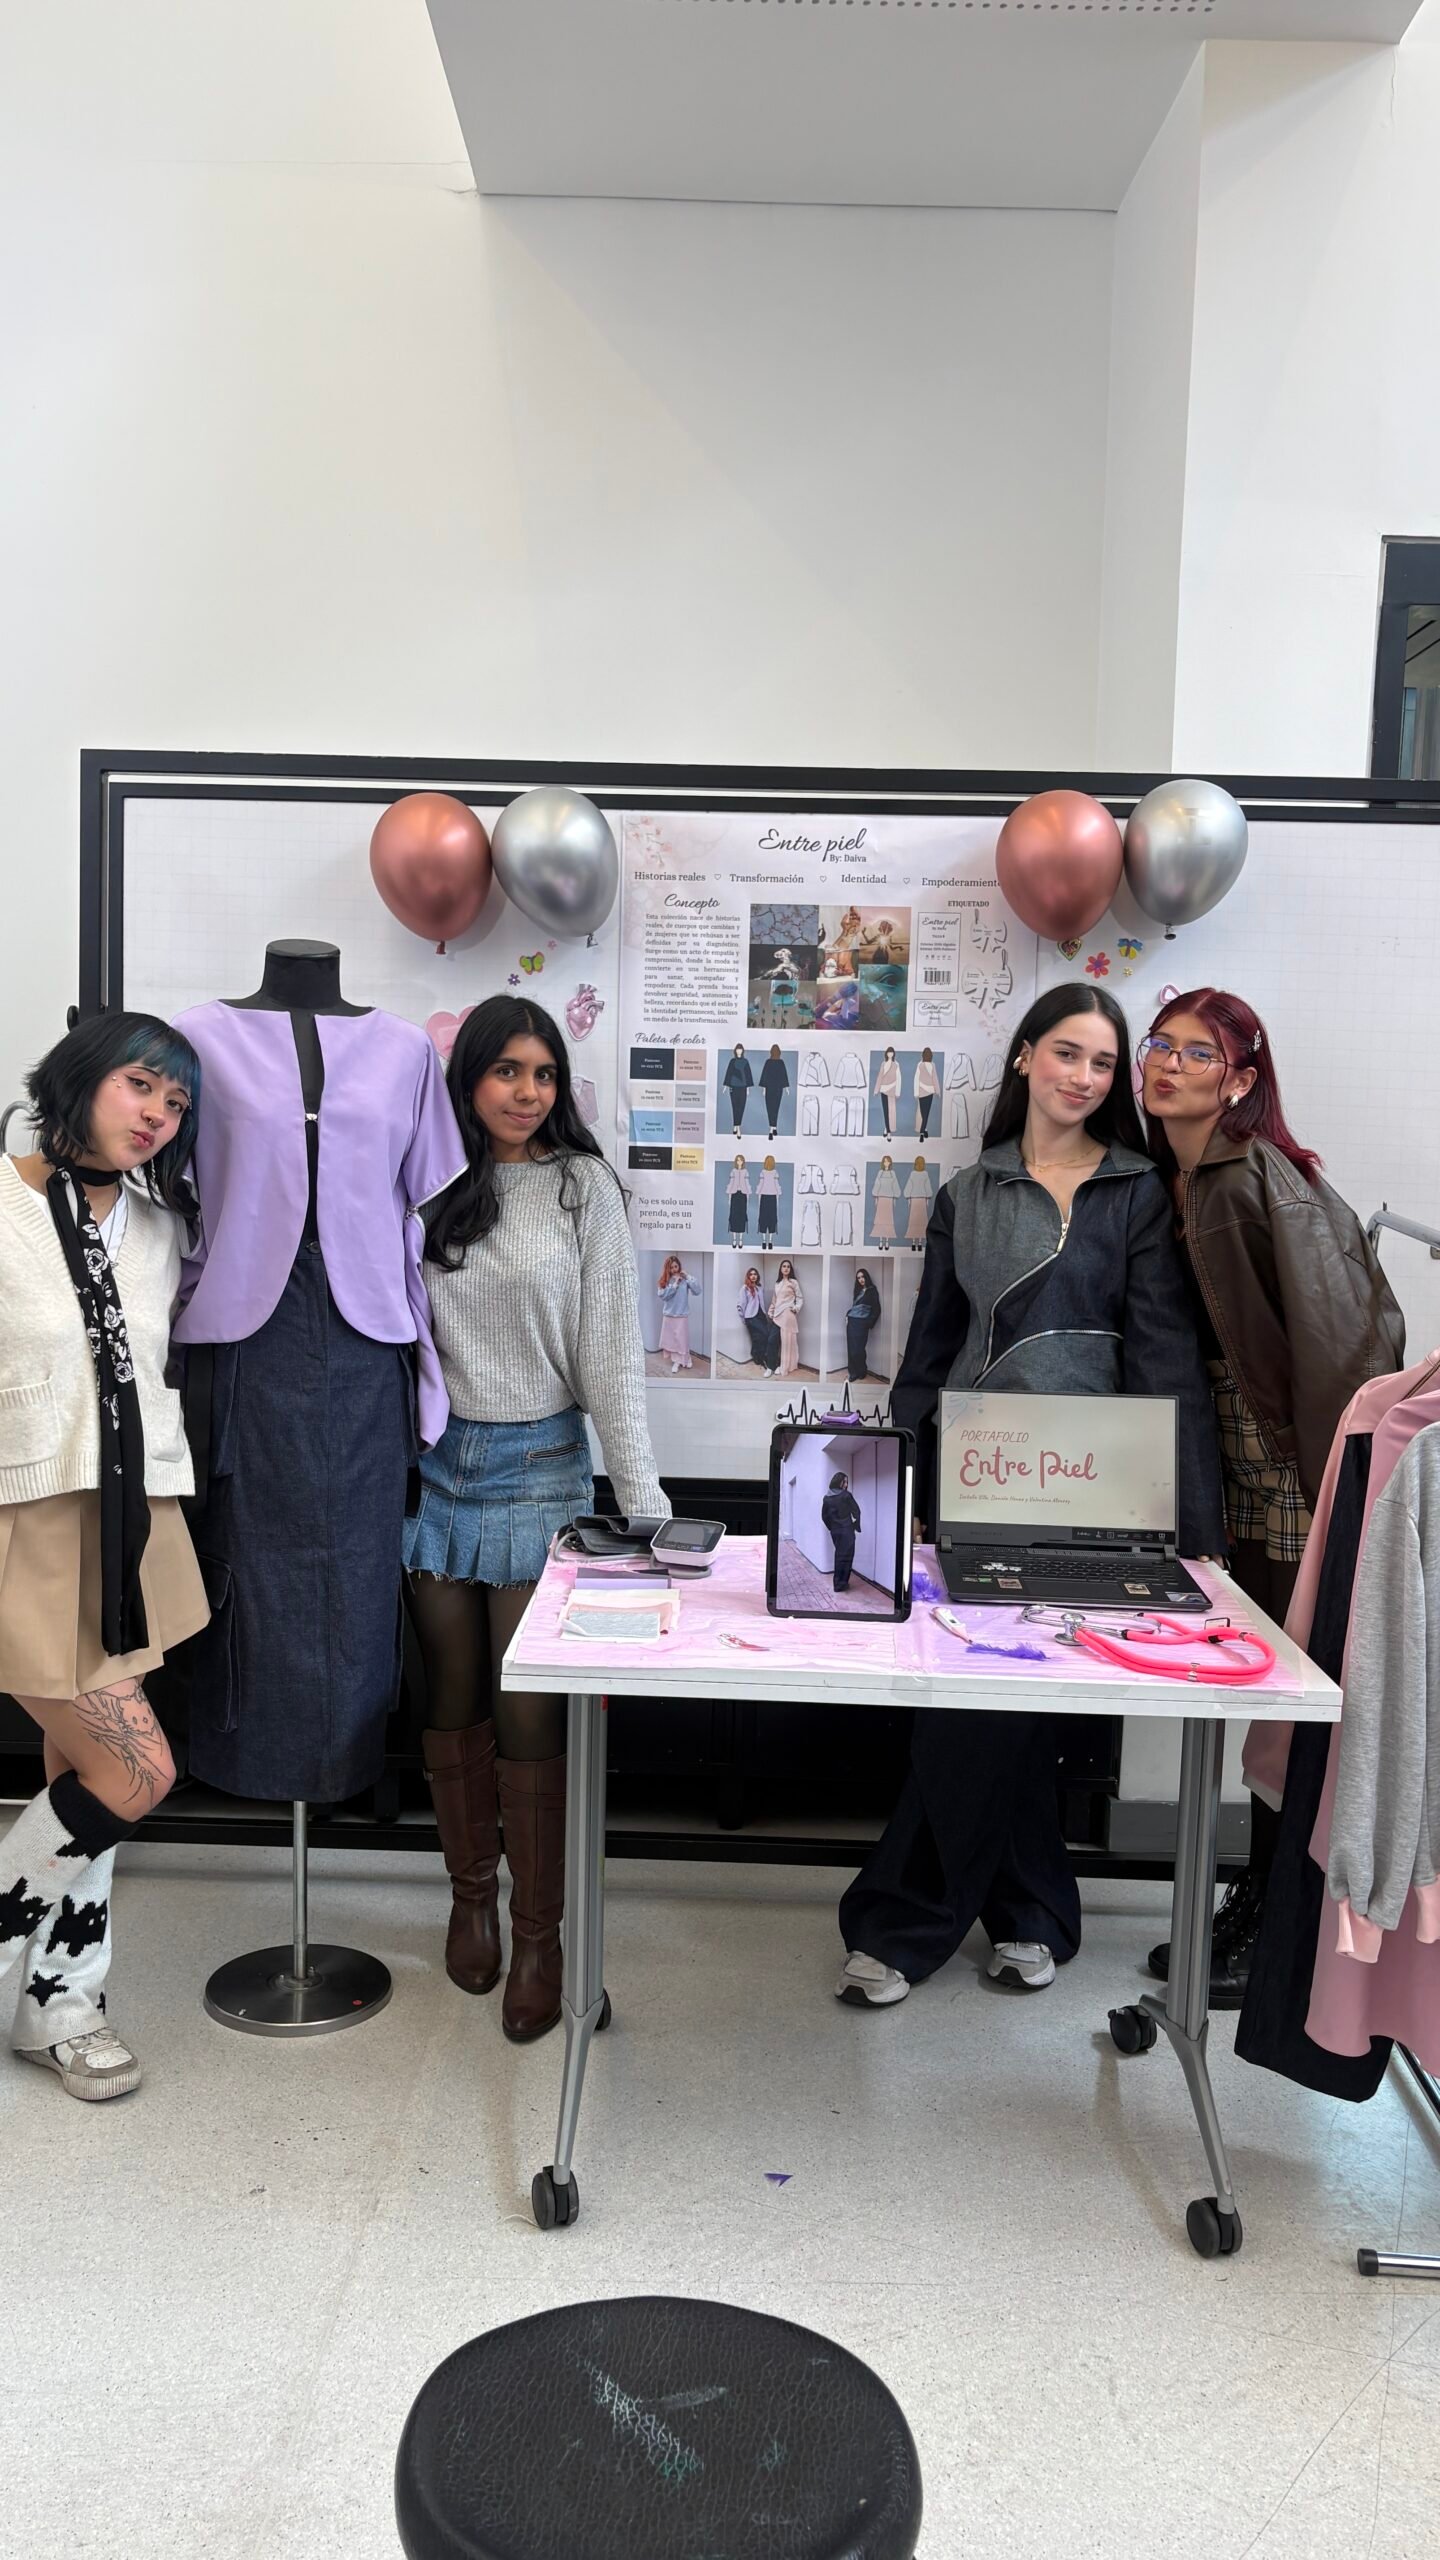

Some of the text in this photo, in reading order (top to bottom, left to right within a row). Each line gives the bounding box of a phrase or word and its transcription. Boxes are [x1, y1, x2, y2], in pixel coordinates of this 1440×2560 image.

[758, 828, 867, 862] Entre piel
[830, 855, 866, 863] By: Daiva
[634, 872, 706, 881] Historias reales
[730, 874, 804, 883] Transformación
[841, 874, 886, 884] Identidad
[664, 894, 720, 914] Concepto
[922, 917, 959, 929] Entre piel
[635, 1033, 706, 1045] Paleta de color
[639, 1210, 669, 1218] prenda,
[640, 1221, 664, 1229] regalo
[960, 1430, 1029, 1443] PORTAFOLIO
[960, 1446, 1097, 1489] Entre Piel
